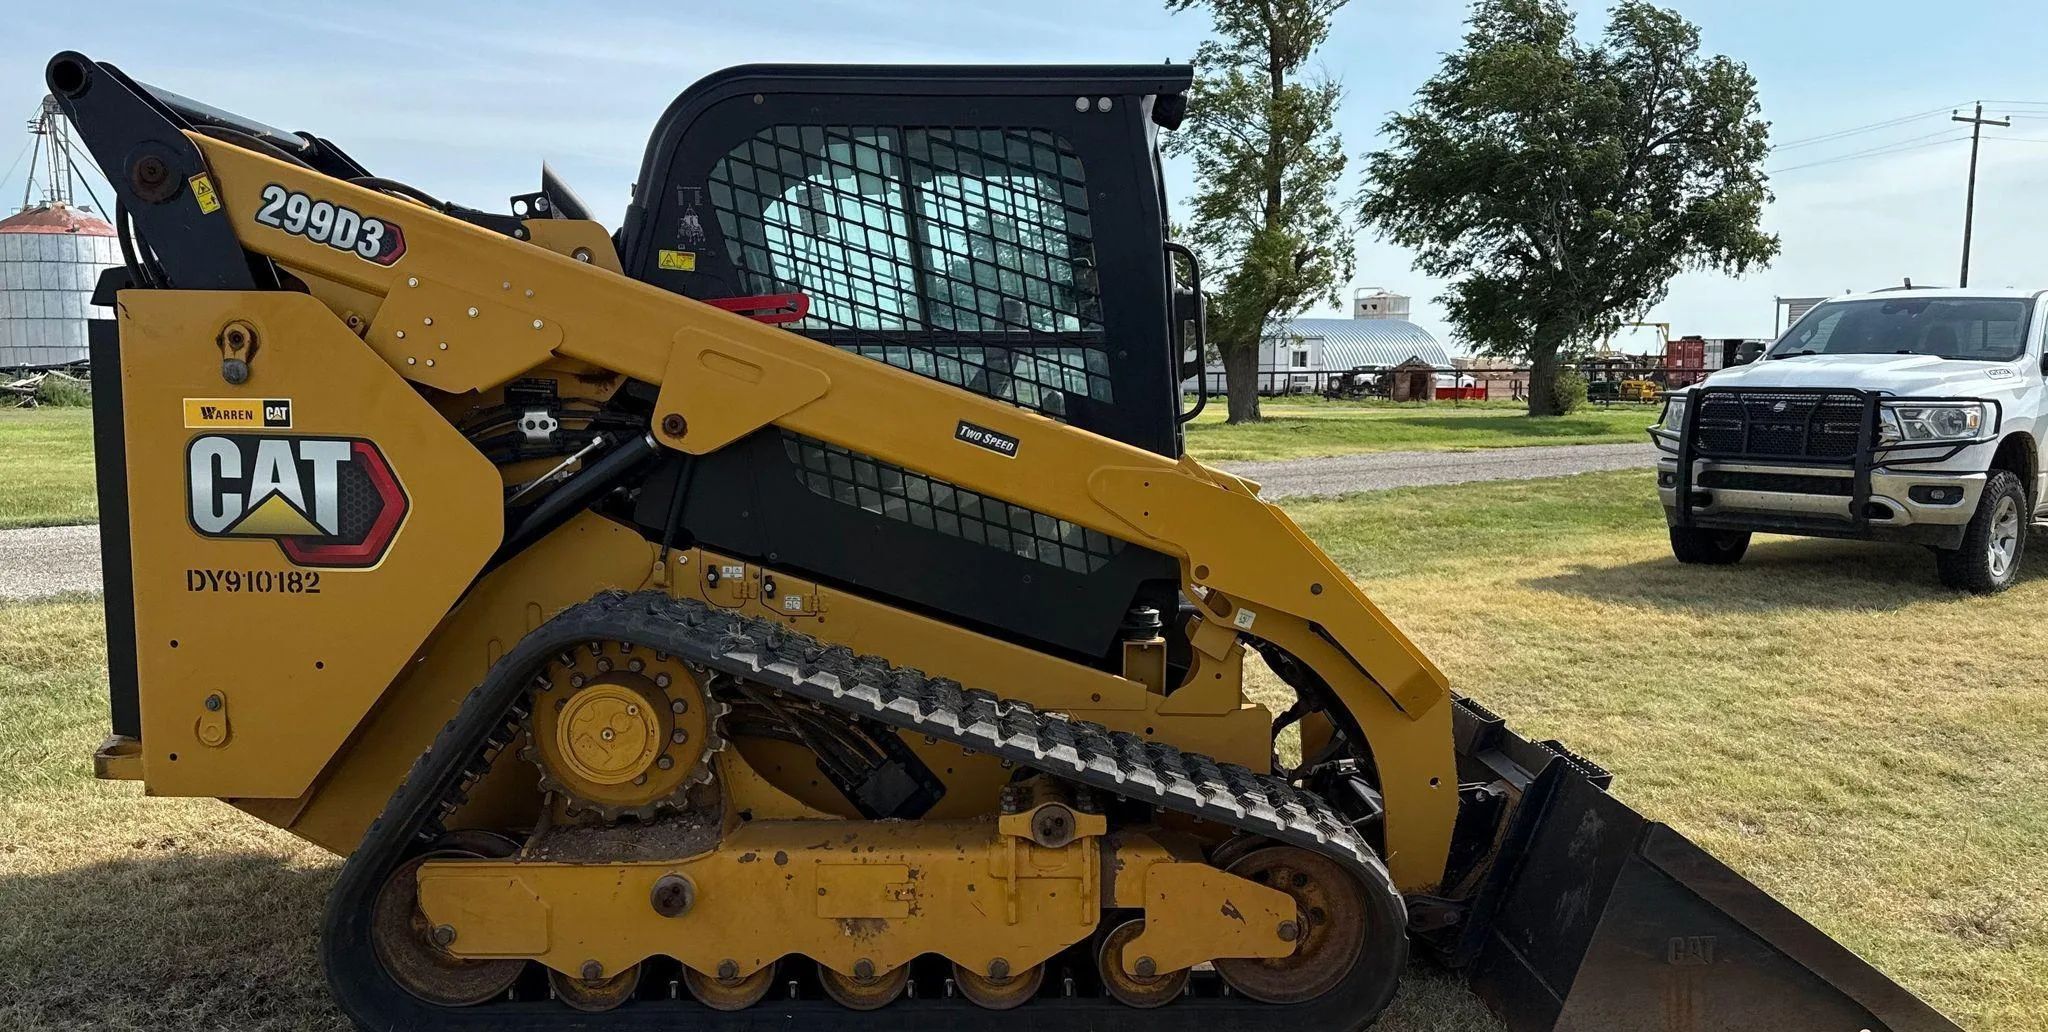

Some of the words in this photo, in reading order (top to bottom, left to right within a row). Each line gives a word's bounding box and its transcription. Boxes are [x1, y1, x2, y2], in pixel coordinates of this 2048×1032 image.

[257, 185, 385, 258] 299D3
[200, 406, 254, 420] WARREN
[265, 406, 289, 421] CAT
[960, 425, 983, 441] TWO
[982, 433, 1015, 452] SPEED
[190, 436, 351, 536] CAT
[186, 569, 321, 594] DY910182
[1667, 935, 1717, 965] CAT
